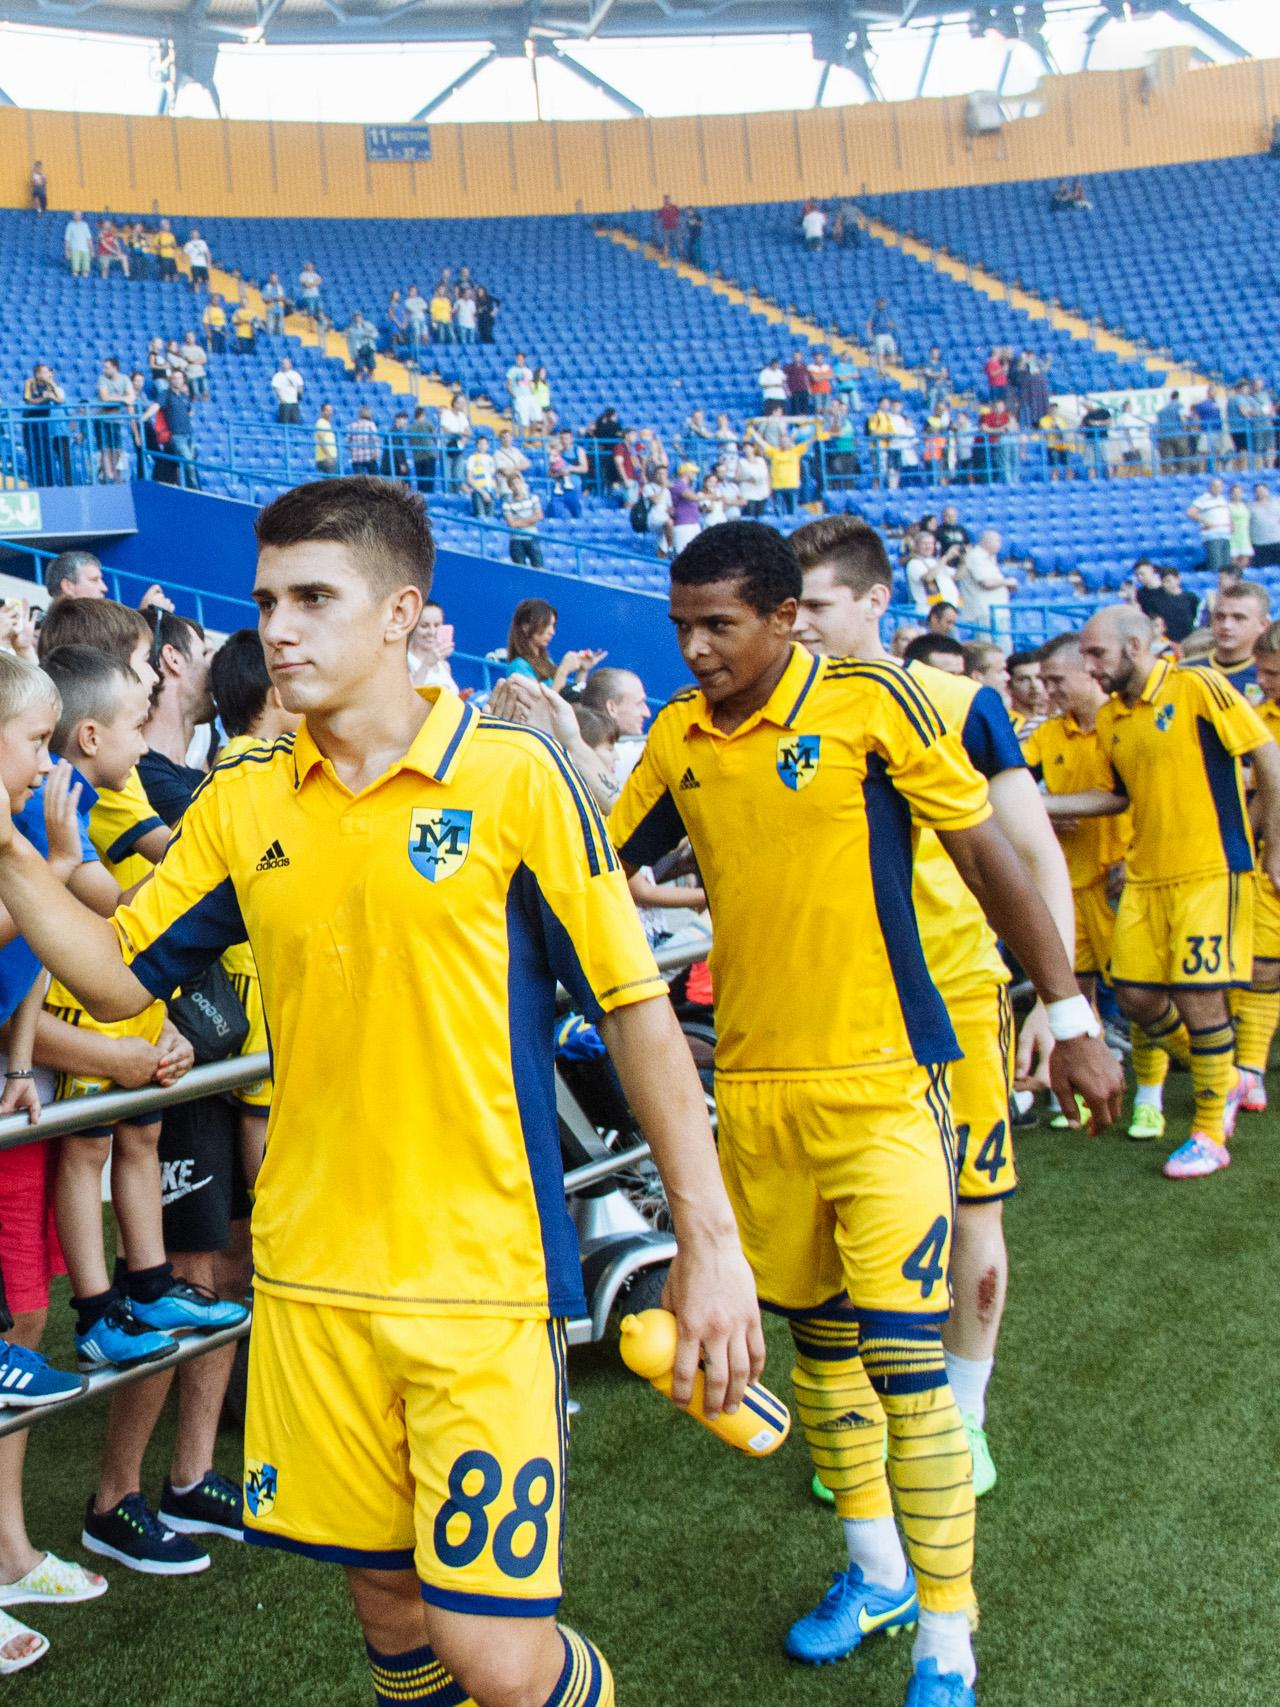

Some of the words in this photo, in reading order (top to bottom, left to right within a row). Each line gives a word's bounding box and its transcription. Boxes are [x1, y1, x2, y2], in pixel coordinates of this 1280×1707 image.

[368, 128, 388, 145] 11
[256, 855, 290, 872] adidas
[1182, 934, 1222, 976] 33
[191, 991, 231, 1037] Reebo
[956, 1119, 1007, 1183] 14
[902, 1215, 948, 1299] 4
[433, 1449, 555, 1578] 88
